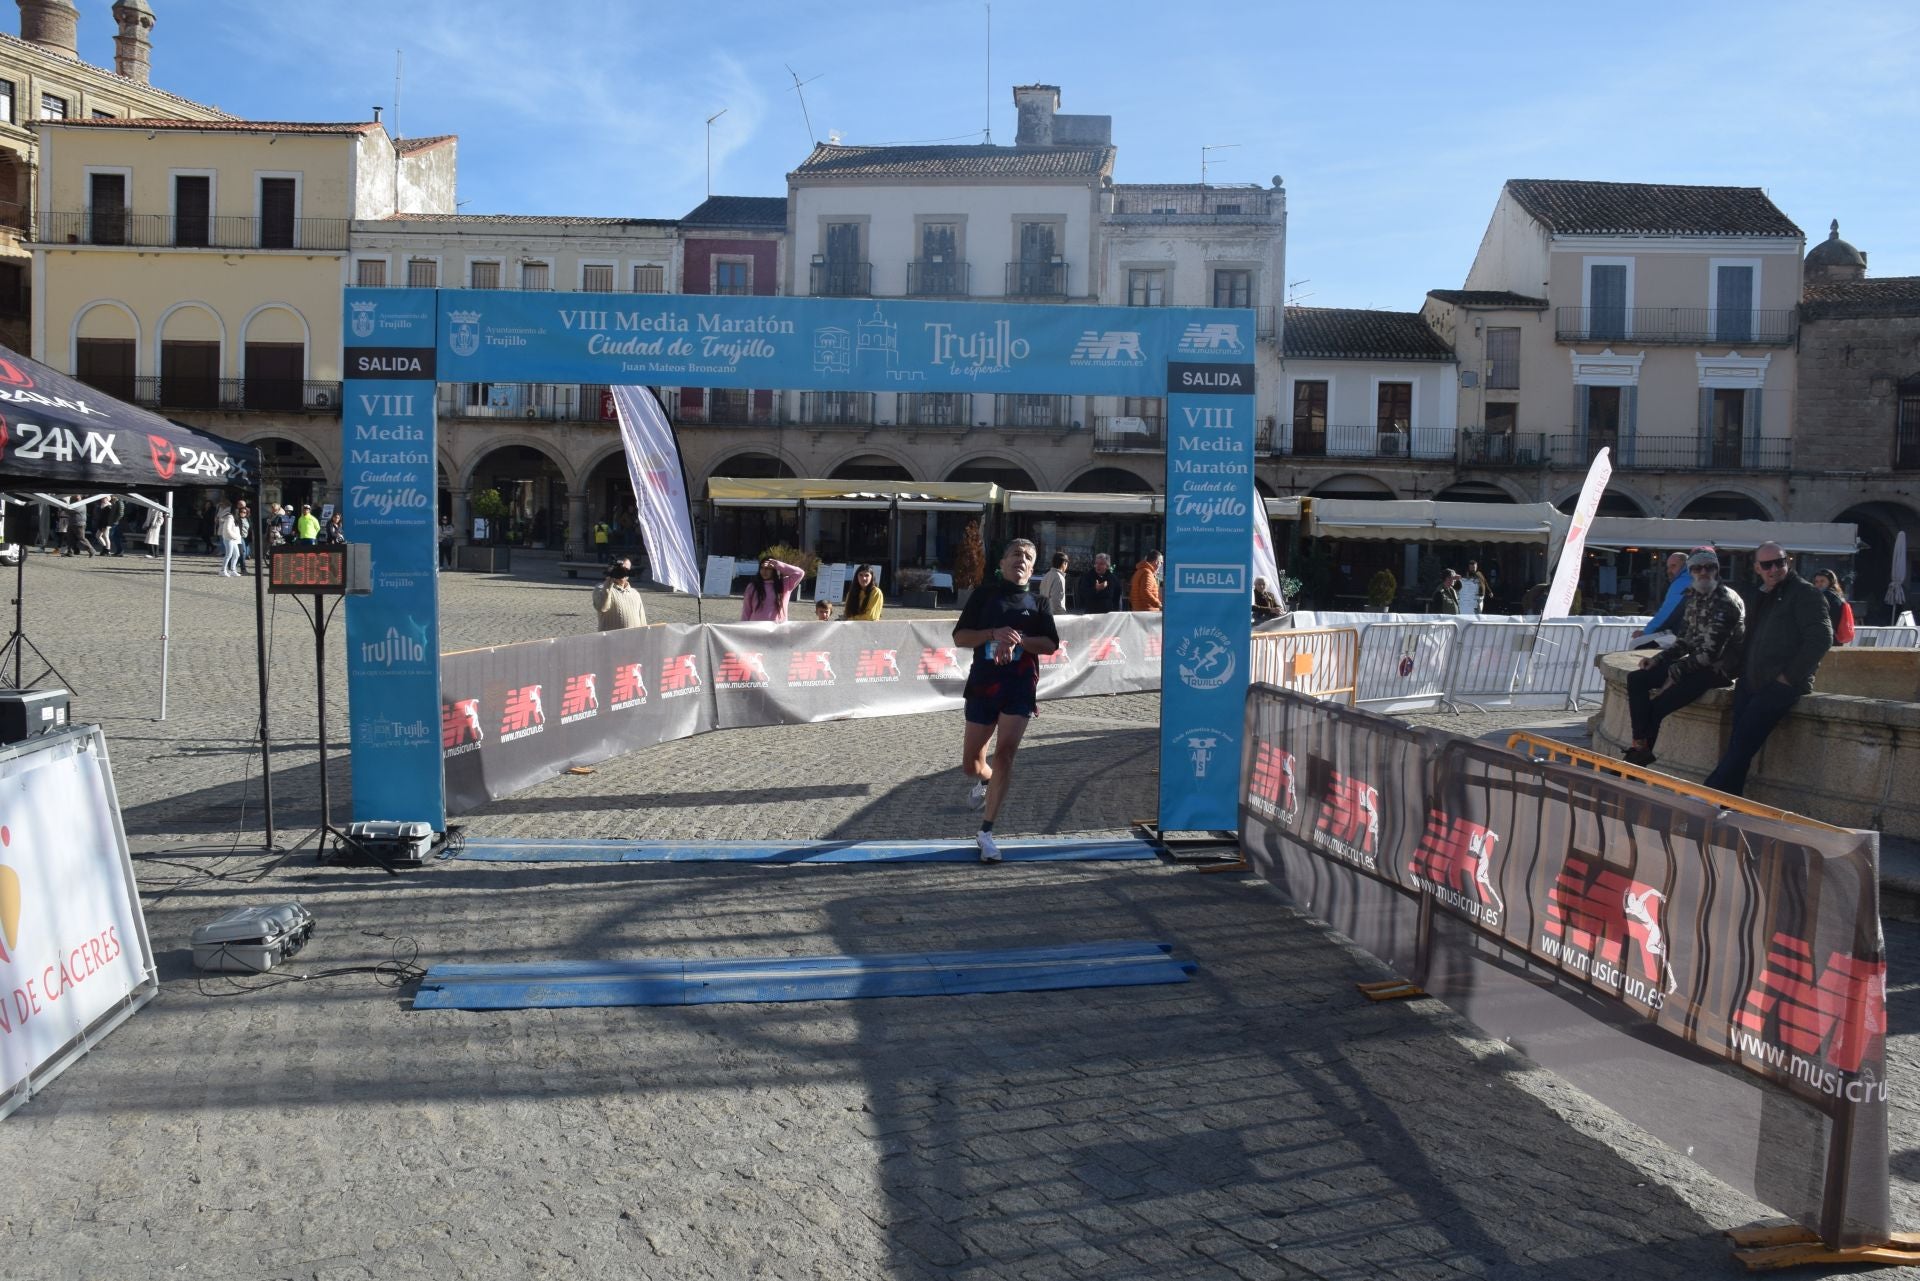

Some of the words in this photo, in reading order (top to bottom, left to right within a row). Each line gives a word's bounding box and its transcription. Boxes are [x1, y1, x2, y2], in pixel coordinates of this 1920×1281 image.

[380, 320, 412, 329] Trujillo
[558, 310, 608, 331] VIII
[615, 311, 689, 333] Media
[696, 313, 795, 335] Maratón
[486, 326, 536, 336] Ayuntamiento
[537, 327, 546, 335] de
[485, 336, 527, 348] Trujillo
[588, 333, 665, 356] Ciudad
[667, 337, 695, 356] de
[700, 335, 776, 365] Trujillo
[924, 319, 1030, 368] Trujillo
[358, 356, 421, 371] SALIDA
[622, 362, 646, 373] Juan
[648, 363, 686, 373] Mateos
[688, 363, 737, 374] Broncano
[1070, 359, 1144, 367] www.musicrun.es
[1182, 371, 1242, 386] SALIDA
[359, 395, 415, 416] VIII
[1182, 407, 1234, 428] VIII
[355, 425, 424, 440] Media
[15, 423, 121, 464] 24MX
[1179, 436, 1244, 451] Media
[351, 449, 430, 464] Maratón
[1175, 459, 1248, 474] Maratón
[361, 470, 401, 482] Ciudad
[403, 472, 417, 482] de
[1183, 480, 1220, 492] Ciudad
[1223, 482, 1237, 492] de
[350, 485, 428, 515] Trujillo
[1174, 494, 1246, 523] Trujillo
[379, 579, 413, 588] Trujillo
[1185, 572, 1235, 585] HABLA
[362, 628, 423, 666] trujillo
[715, 681, 769, 689] www.musicrun.es
[788, 679, 835, 687] www.musicrun.es
[855, 675, 899, 683] www.musicrun.es
[1184, 674, 1223, 686] TRUJILLO
[661, 685, 700, 699] www.musicrun.es
[611, 697, 647, 711] www.musicrun.es
[561, 708, 597, 724] www.musicrun.es
[391, 720, 430, 738] Trujillo
[501, 724, 544, 743] www.musicrun.es
[1248, 793, 1293, 825] www.musicrun.es
[1314, 829, 1375, 870] www.musicrun.es
[1410, 873, 1498, 926] www.musicrun.es
[13, 978, 41, 1025] DE
[43, 926, 120, 1000] CÁCERES
[1542, 933, 1664, 1011] www.musicrun.es
